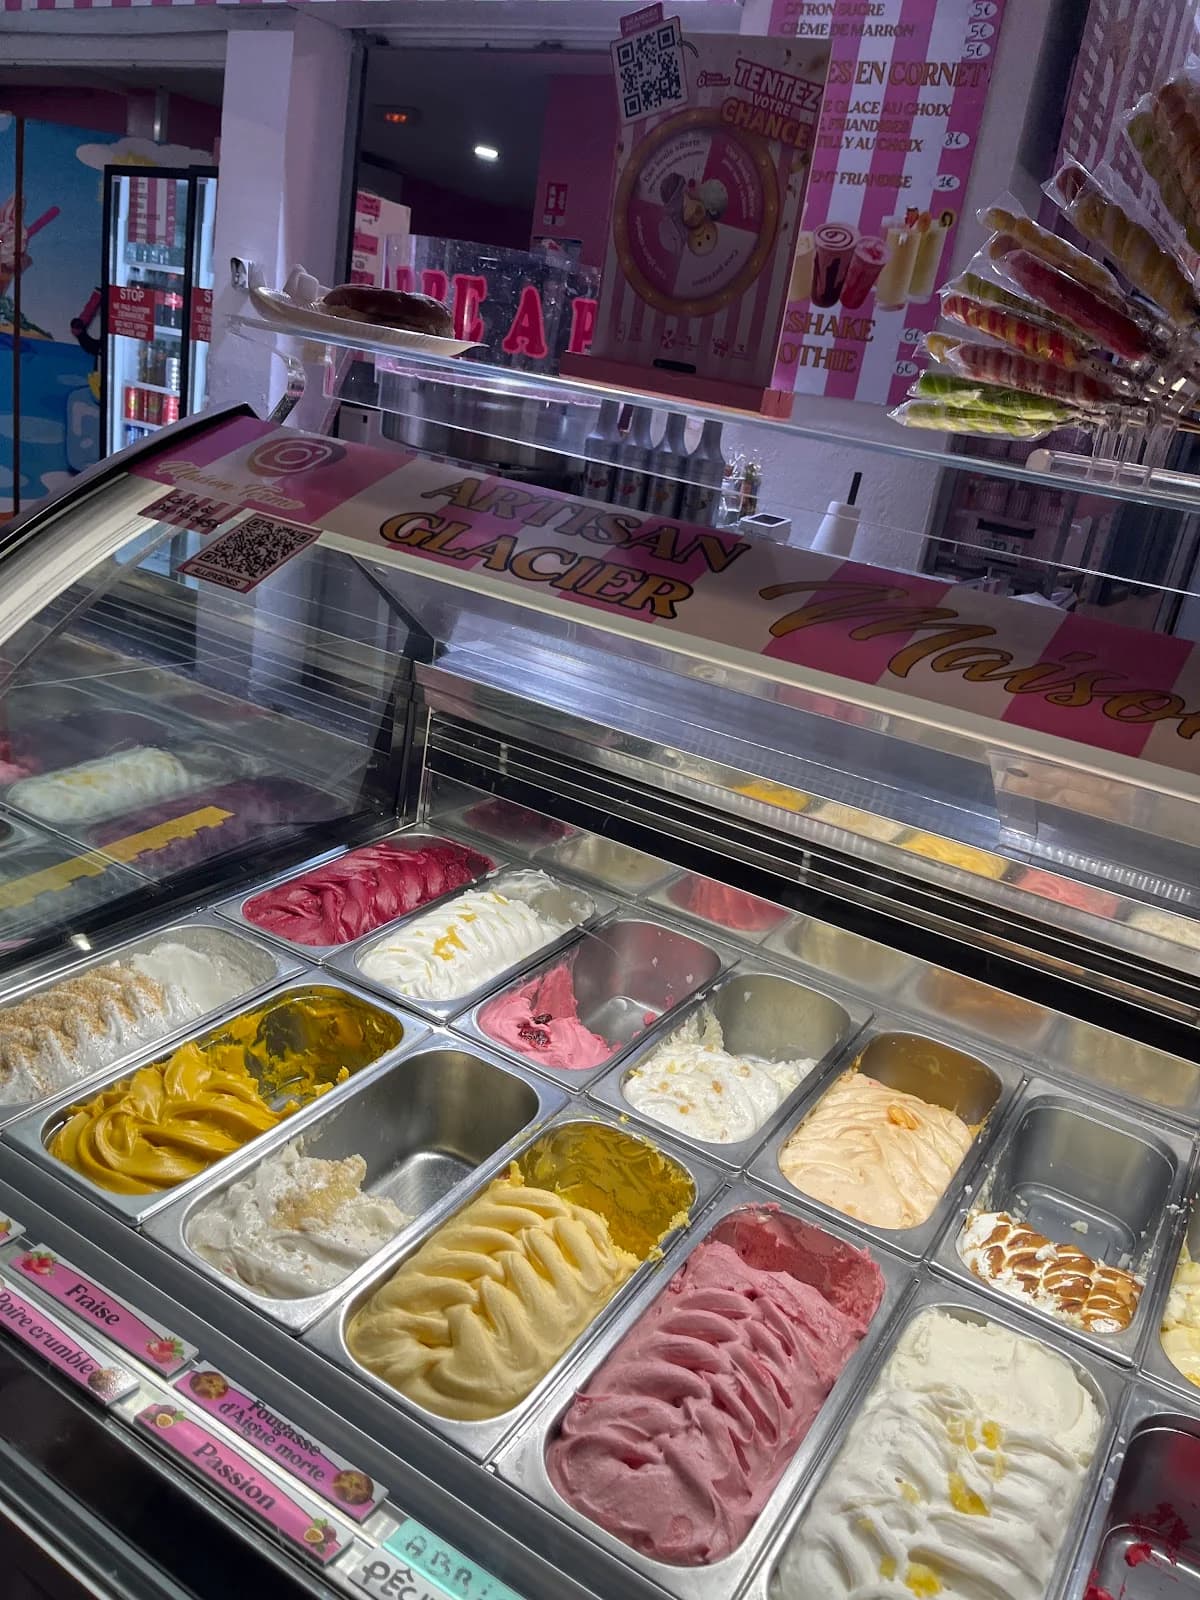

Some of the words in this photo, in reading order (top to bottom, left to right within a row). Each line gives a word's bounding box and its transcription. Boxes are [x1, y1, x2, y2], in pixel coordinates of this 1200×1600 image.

[784, 3, 834, 16] CITRON
[830, 23, 849, 37] DE
[850, 24, 915, 38] MARRON
[735, 59, 823, 111] TENTEZ
[855, 61, 886, 85] EN
[889, 62, 987, 88] CORNET
[721, 97, 811, 148] CHANCE
[753, 95, 791, 116] VOTRE
[834, 101, 880, 115] GLACE
[905, 103, 952, 117] CHOIX
[855, 137, 875, 150] AU
[120, 288, 144, 302] STOP
[420, 478, 752, 572] ARTISAN
[379, 512, 694, 619] GLACIER
[65, 1283, 120, 1326] Fraise
[29, 1325, 94, 1375] crumble
[218, 1402, 276, 1446] d'Aigue
[277, 1443, 325, 1482] morte
[247, 1399, 322, 1457] Fougasse
[193, 1441, 277, 1511] Passion
[362, 1560, 434, 1600] PÊC
